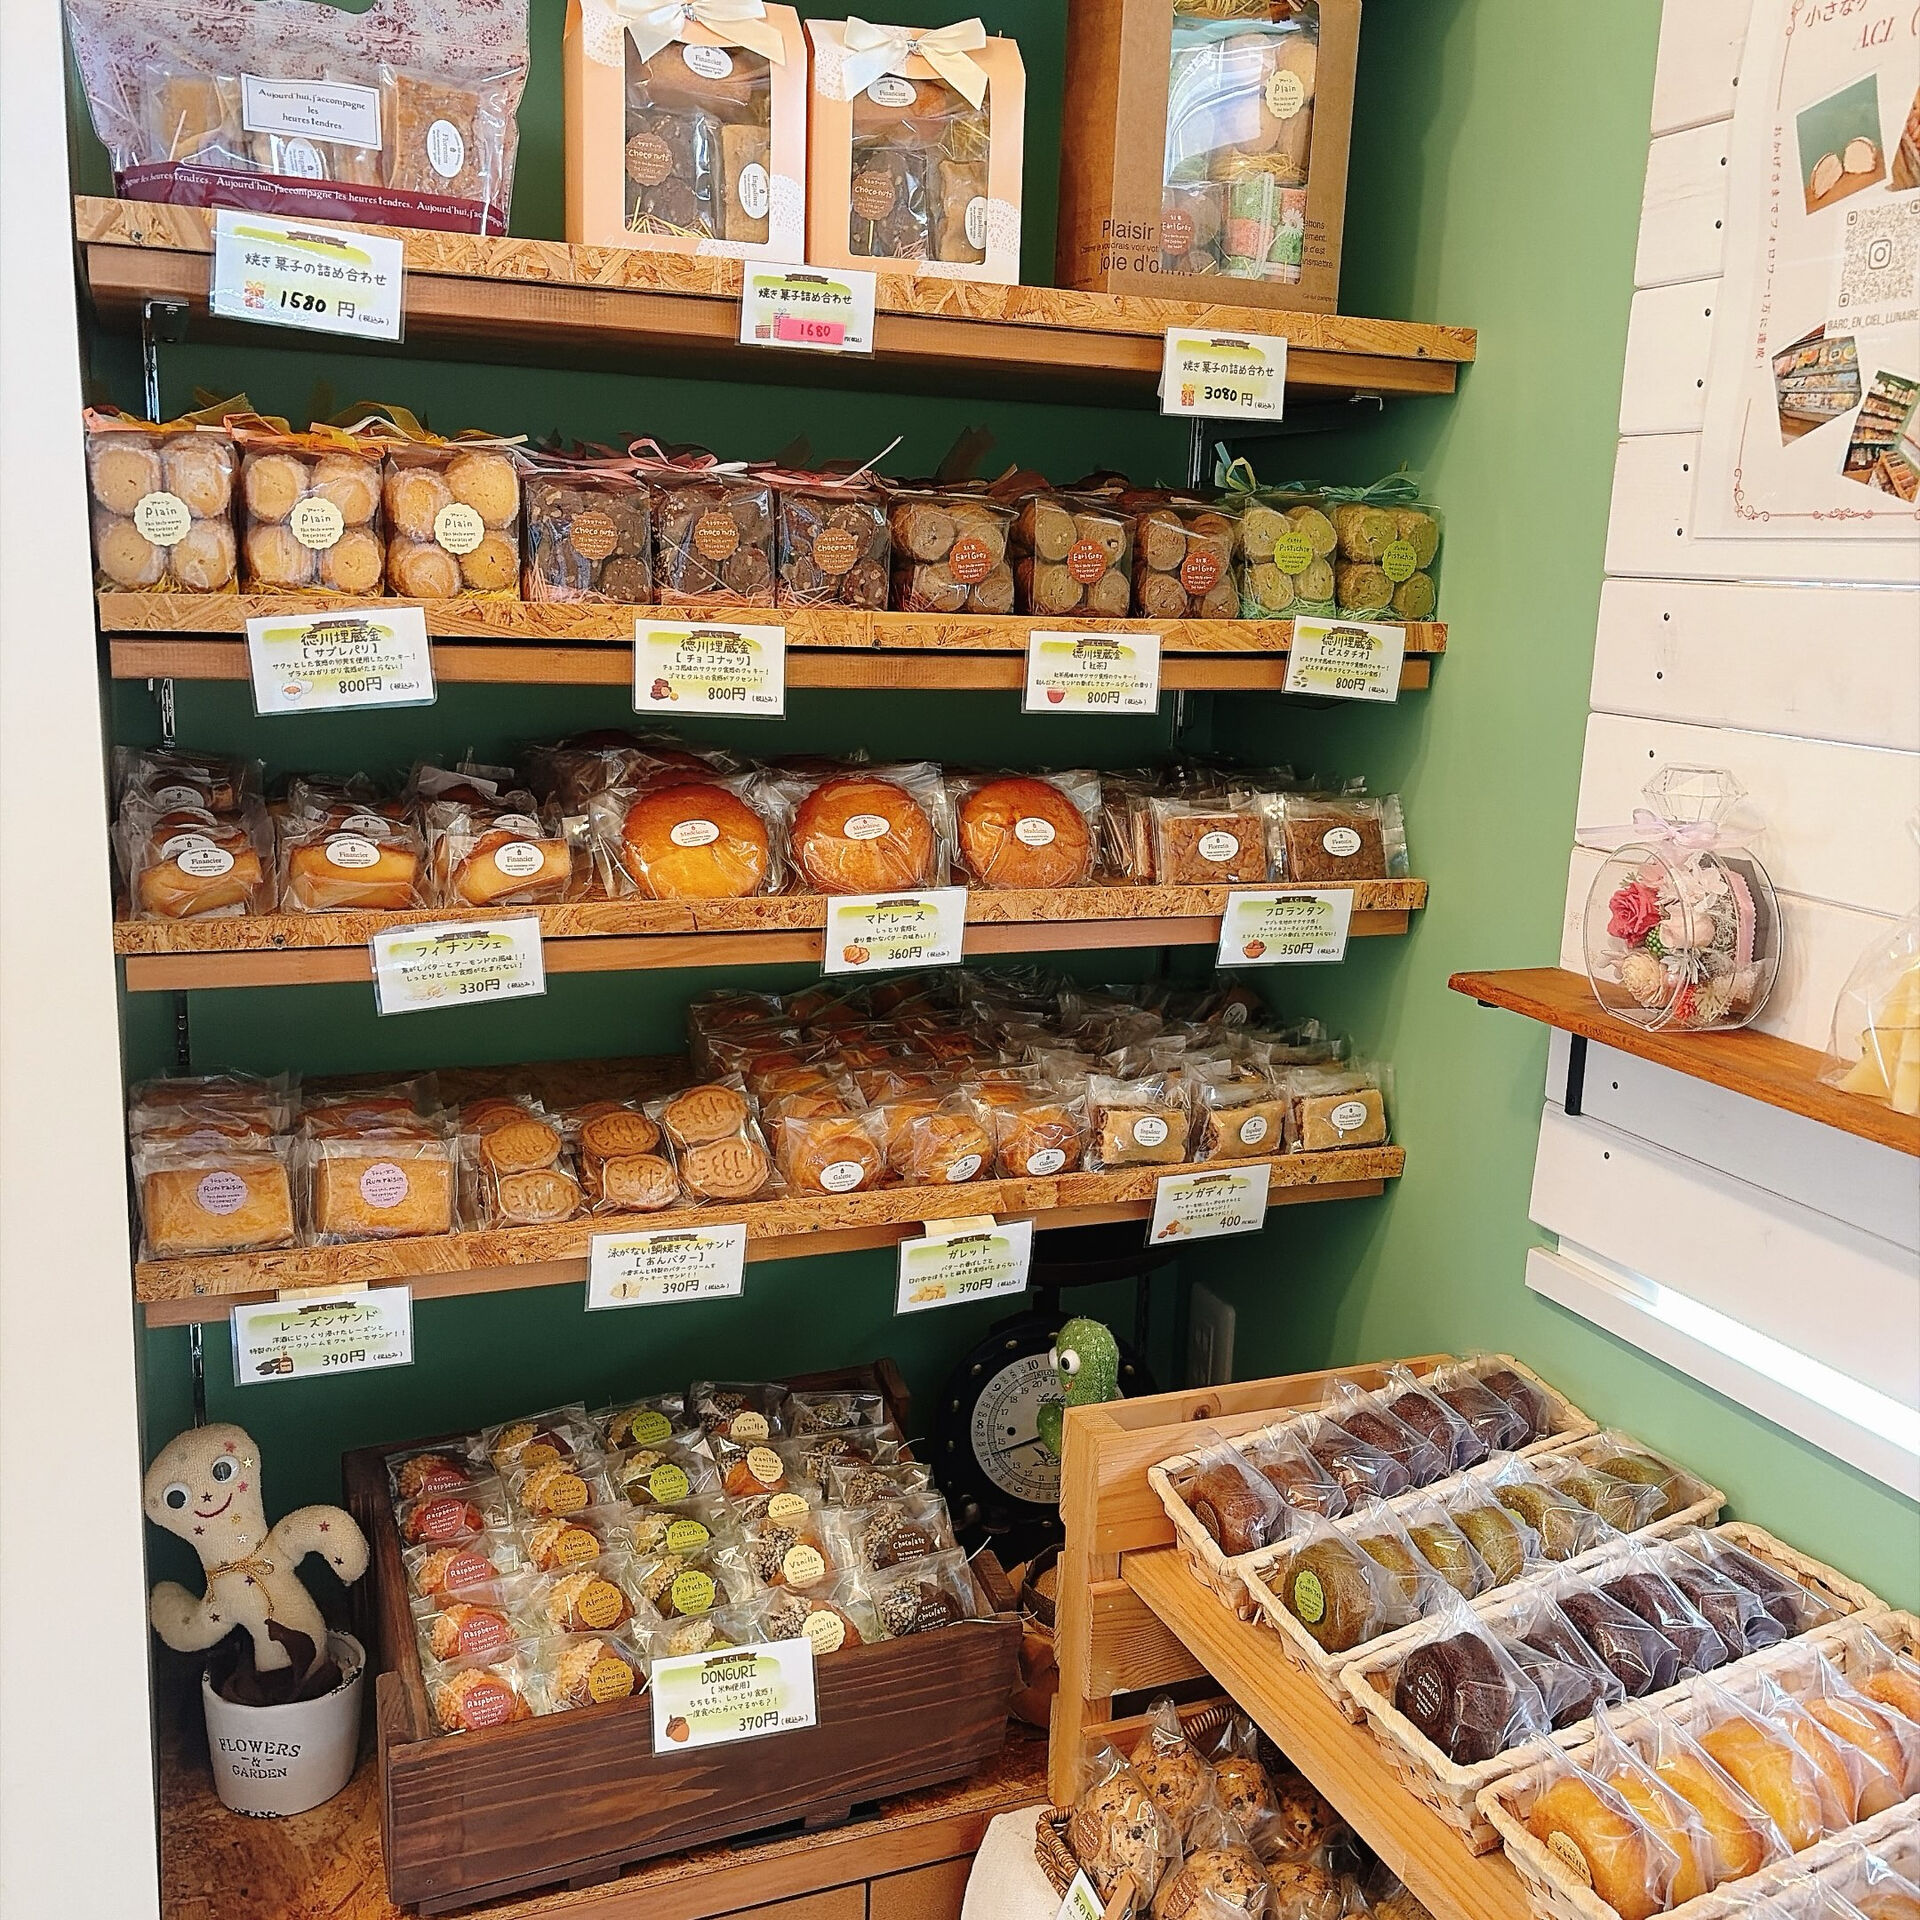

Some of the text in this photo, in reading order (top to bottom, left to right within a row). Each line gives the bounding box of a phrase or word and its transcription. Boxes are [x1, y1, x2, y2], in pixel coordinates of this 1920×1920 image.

[1274, 84, 1297, 94] Plain
[307, 106, 319, 115] les
[282, 113, 310, 125] heures
[174, 170, 212, 184] tendres.
[335, 190, 347, 200] les
[349, 193, 378, 204] heures
[378, 197, 413, 209] tendres.
[1101, 219, 1155, 240] Plaisir
[1160, 221, 1177, 231] Earl
[244, 252, 388, 287] 焼き菓子の詰め合わせ
[1098, 252, 1127, 275] joie
[758, 288, 853, 305] 焼き菓子詰め合わせ
[280, 290, 390, 327] 1580 円 (税込み)
[800, 324, 831, 338] 1680
[1182, 360, 1275, 377] 焼き菓子の詰め合わせ
[1204, 386, 1237, 402] 3080
[1240, 392, 1254, 407] 円
[146, 507, 177, 519] Plain
[301, 513, 331, 525] Plain
[445, 518, 473, 529] Plain
[574, 527, 598, 535] Choco
[955, 552, 987, 562] Earl Grey
[1073, 552, 1103, 561] Earl Grey
[1202, 565, 1216, 573] Grey
[300, 628, 383, 646] 徳川埋蔵金
[1321, 634, 1376, 650] 徳川埋蔵金
[680, 639, 753, 655] 徳川埋蔵金
[1072, 648, 1123, 660] 徳川埋蔵金
[338, 676, 420, 694] 800円 (税込み)
[1336, 676, 1366, 691] 800円
[708, 686, 778, 703] 800円 (税込み)
[1087, 691, 1120, 704] 800円
[191, 857, 222, 866] Financier
[339, 851, 369, 859] Financier
[865, 911, 925, 924] マドレーヌ
[1266, 906, 1326, 916] フロランタン
[416, 940, 502, 957] フィナンシェ
[888, 946, 922, 960] 360円
[1280, 942, 1314, 955] 350円
[459, 978, 535, 994] 330円 (税込み)
[1172, 1184, 1247, 1202] エンガディナー
[1220, 1216, 1241, 1228] 400
[948, 1245, 990, 1260] ガレット
[662, 1280, 700, 1294] 390円
[958, 1277, 993, 1294] 370円
[281, 1310, 378, 1332] レーズンサンド
[322, 1350, 403, 1367] 390円 (税込み)
[1026, 1360, 1039, 1370] 10
[976, 1420, 984, 1429] 8
[752, 1456, 778, 1464] Vanilla
[428, 1480, 461, 1492] Raspberry
[552, 1486, 581, 1497] Almond
[426, 1504, 460, 1520] Raspberry
[892, 1537, 926, 1550] Chocolate
[450, 1562, 486, 1578] Raspberry
[584, 1593, 614, 1608] Almond
[917, 1606, 948, 1622] Chocolate
[462, 1623, 500, 1640] Raspberry
[596, 1672, 626, 1684] Almond
[701, 1664, 757, 1685] DONGURI
[466, 1692, 504, 1710] Raspberry
[690, 1688, 773, 1708] もちもち、しっとり食感！
[739, 1711, 809, 1732] 370円 (税込み)
[218, 1738, 301, 1758] FLOWERS
[232, 1764, 288, 1779] GARDEN
